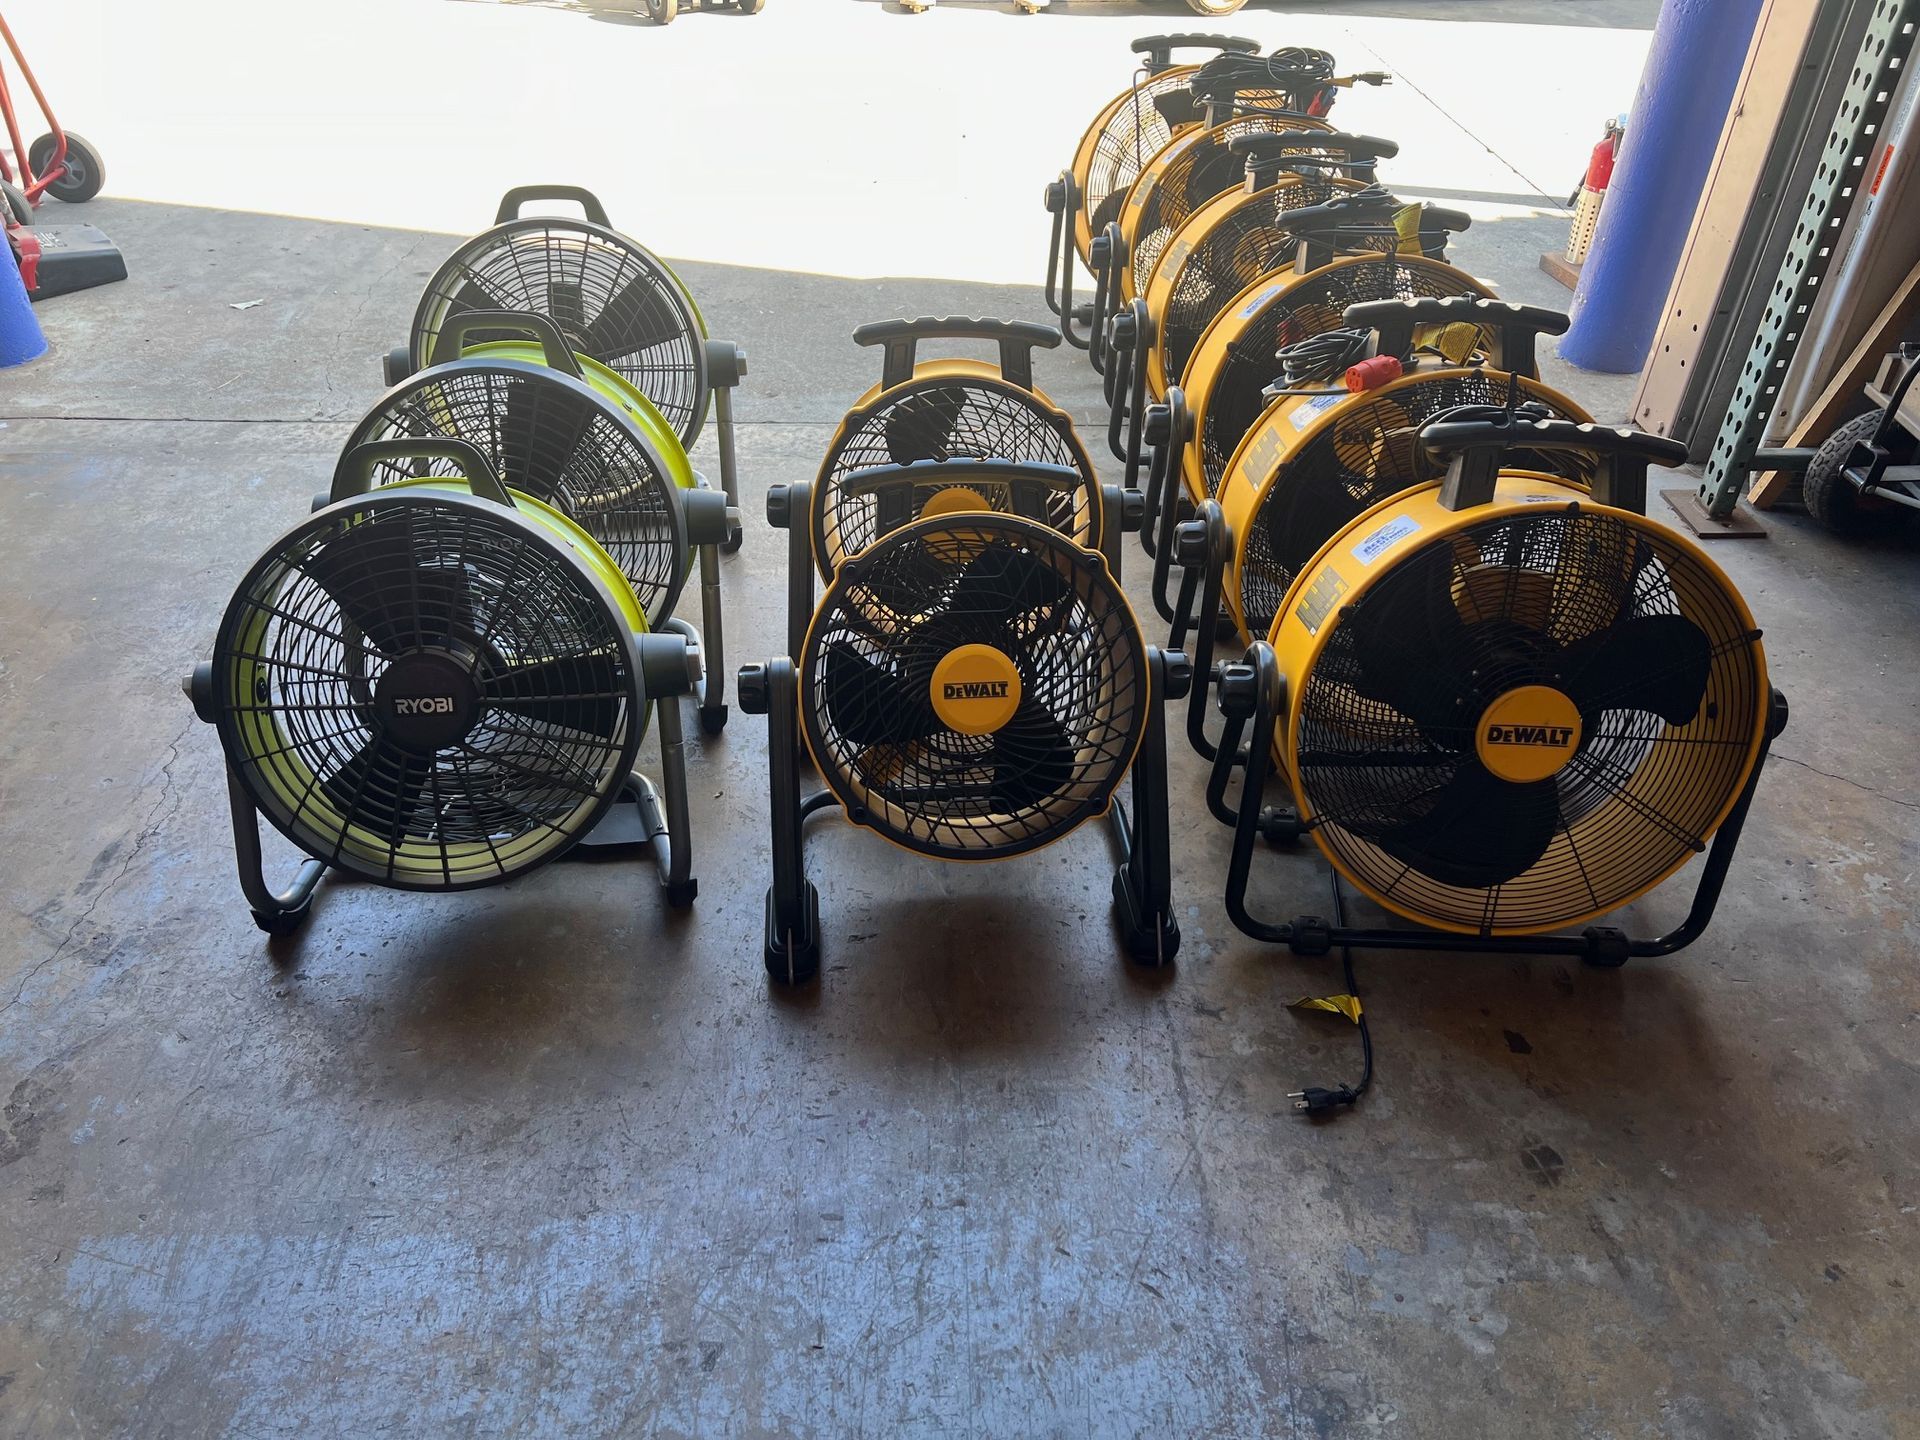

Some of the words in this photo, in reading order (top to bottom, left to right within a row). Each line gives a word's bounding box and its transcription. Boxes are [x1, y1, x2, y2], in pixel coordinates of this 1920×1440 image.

[480, 535, 527, 551] RYO
[944, 682, 1008, 699] DEWALT
[395, 697, 453, 714] RYOBI
[1488, 726, 1573, 746] DEWALT
